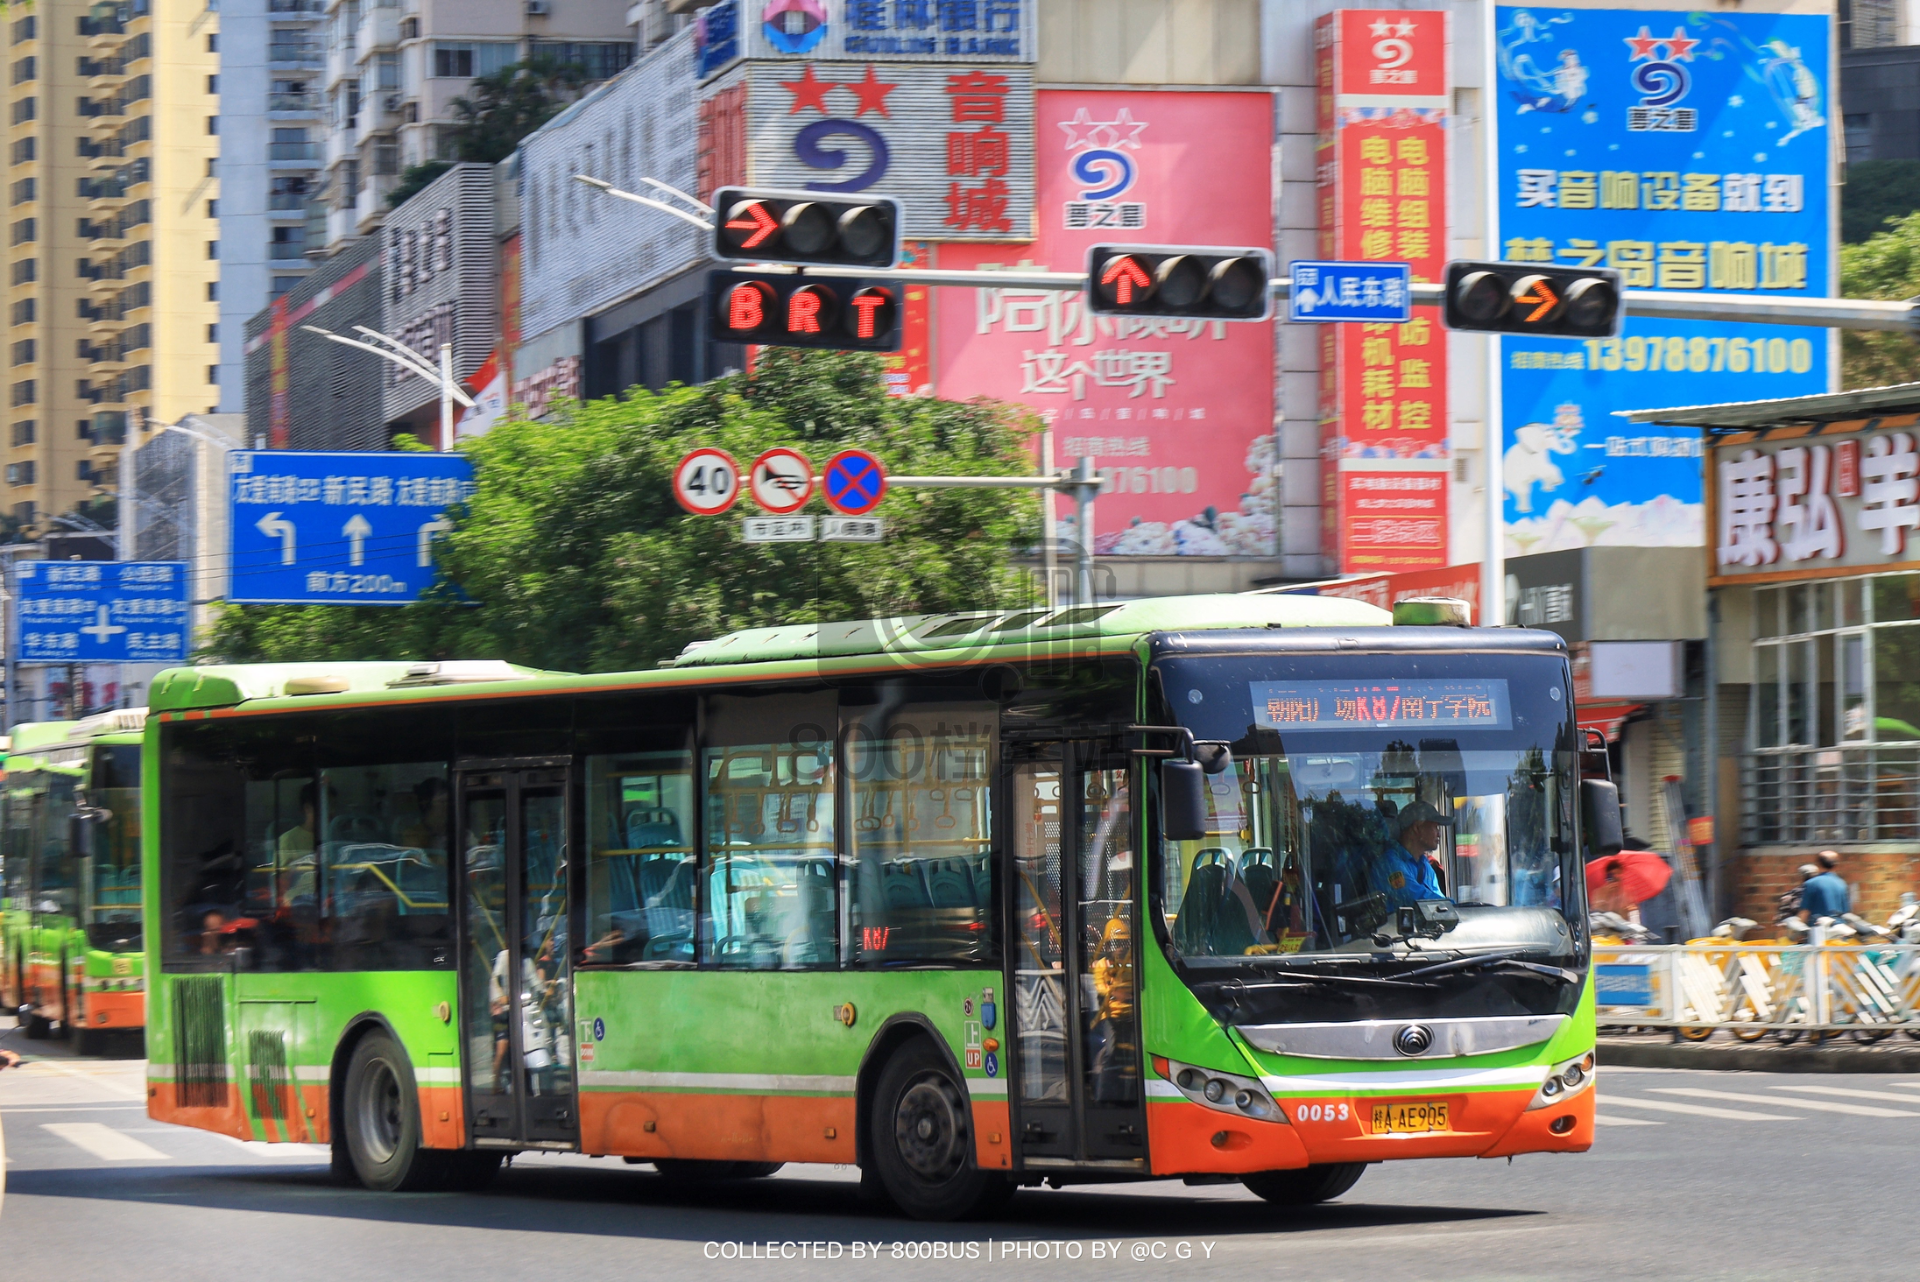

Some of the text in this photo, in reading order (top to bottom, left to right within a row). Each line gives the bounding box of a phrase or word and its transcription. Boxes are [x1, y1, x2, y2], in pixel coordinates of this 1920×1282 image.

[945, 70, 1013, 233] 音响城
[1360, 135, 1394, 260] 电脑维修
[1397, 136, 1431, 260] 电脑组装
[1516, 168, 1804, 212] 买音响设备就到
[1317, 275, 1406, 308] 人民东路
[1397, 275, 1432, 430] 防监控
[1583, 335, 1813, 374] 13978876100
[1020, 349, 1177, 400] 这个世界
[321, 475, 395, 506] 新民路
[683, 465, 731, 497] 40
[967, 1052, 980, 1066] UP
[1297, 1103, 1350, 1122] 0053
